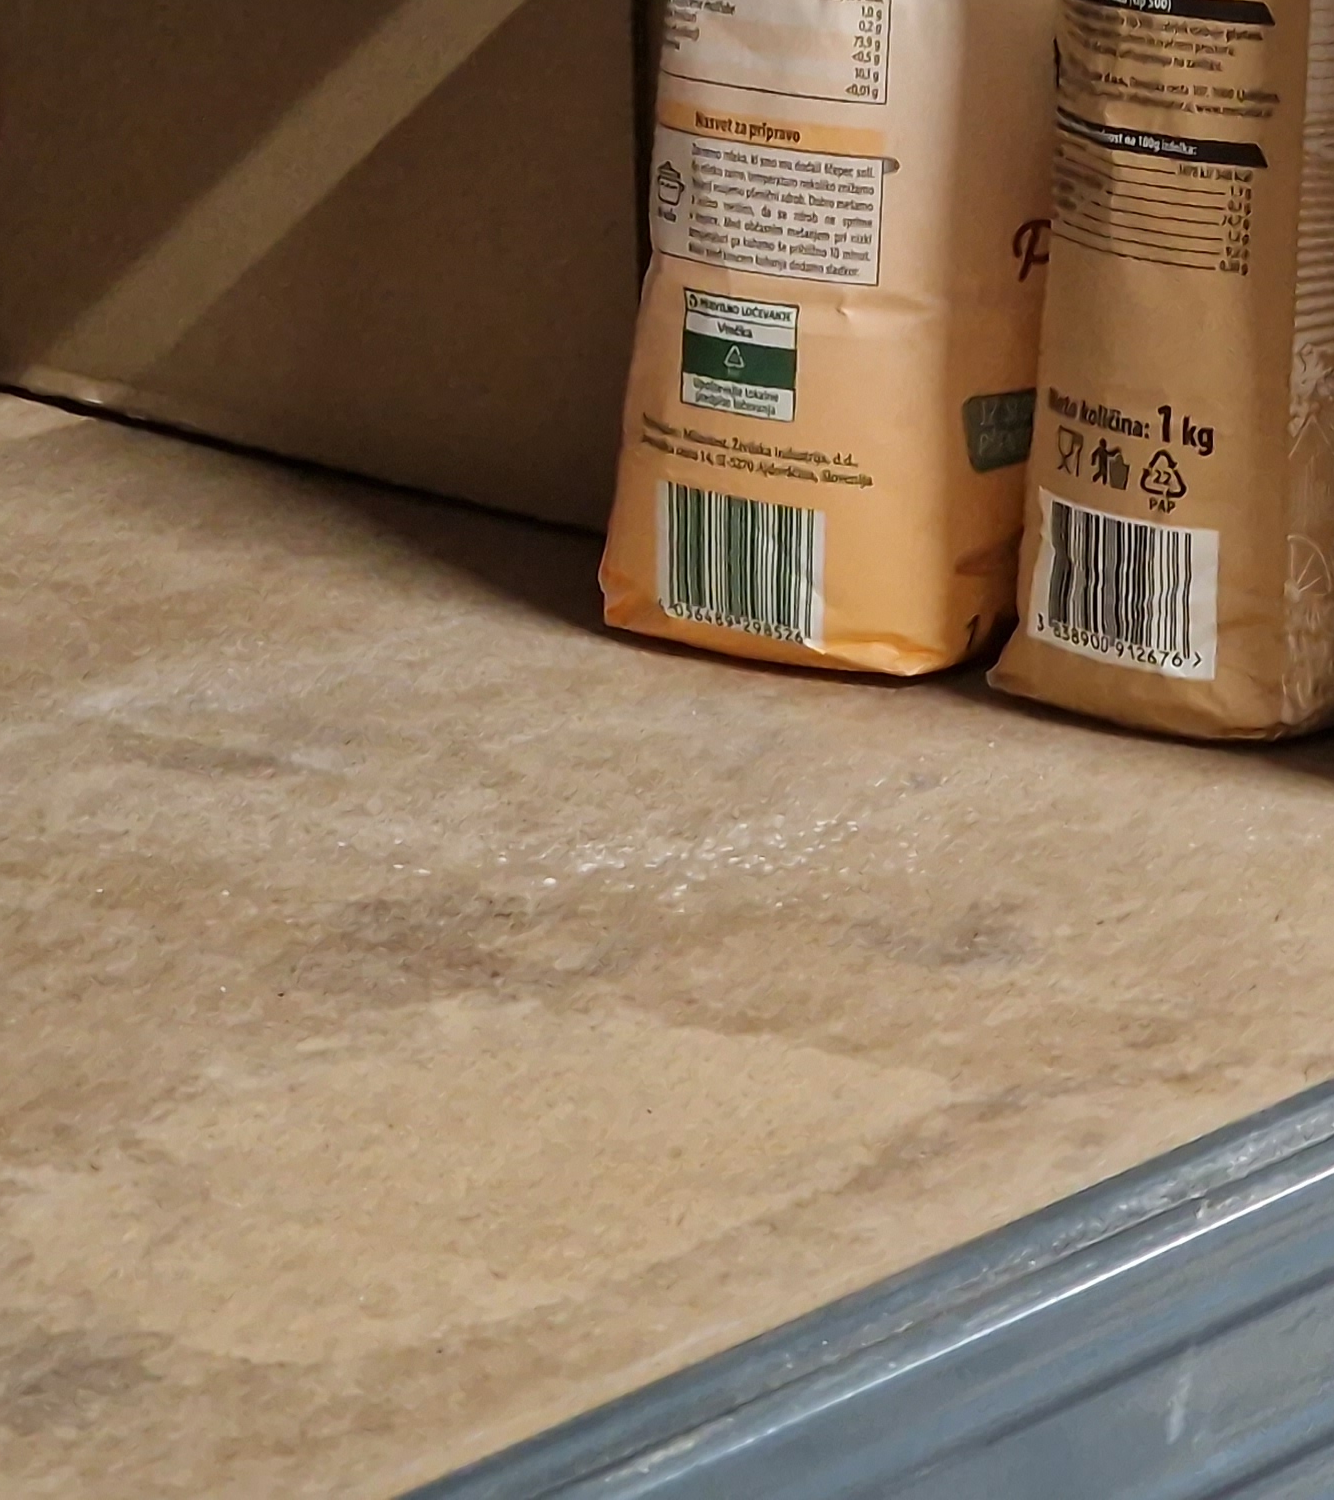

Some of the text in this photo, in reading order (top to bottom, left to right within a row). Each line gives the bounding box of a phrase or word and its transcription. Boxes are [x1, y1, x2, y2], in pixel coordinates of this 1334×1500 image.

[876, 9, 882, 21] g
[875, 23, 882, 35] g
[874, 39, 881, 52] g
[873, 54, 880, 66] g
[873, 71, 879, 83] g
[871, 87, 879, 100] g
[734, 121, 747, 135] za
[748, 121, 801, 144] pripravo
[1079, 400, 1151, 440] količina:
[1157, 404, 1172, 443] 1
[1182, 416, 1215, 457] kg
[1148, 497, 1177, 515] PAP
[1036, 612, 1184, 669] 3 838900 912676
